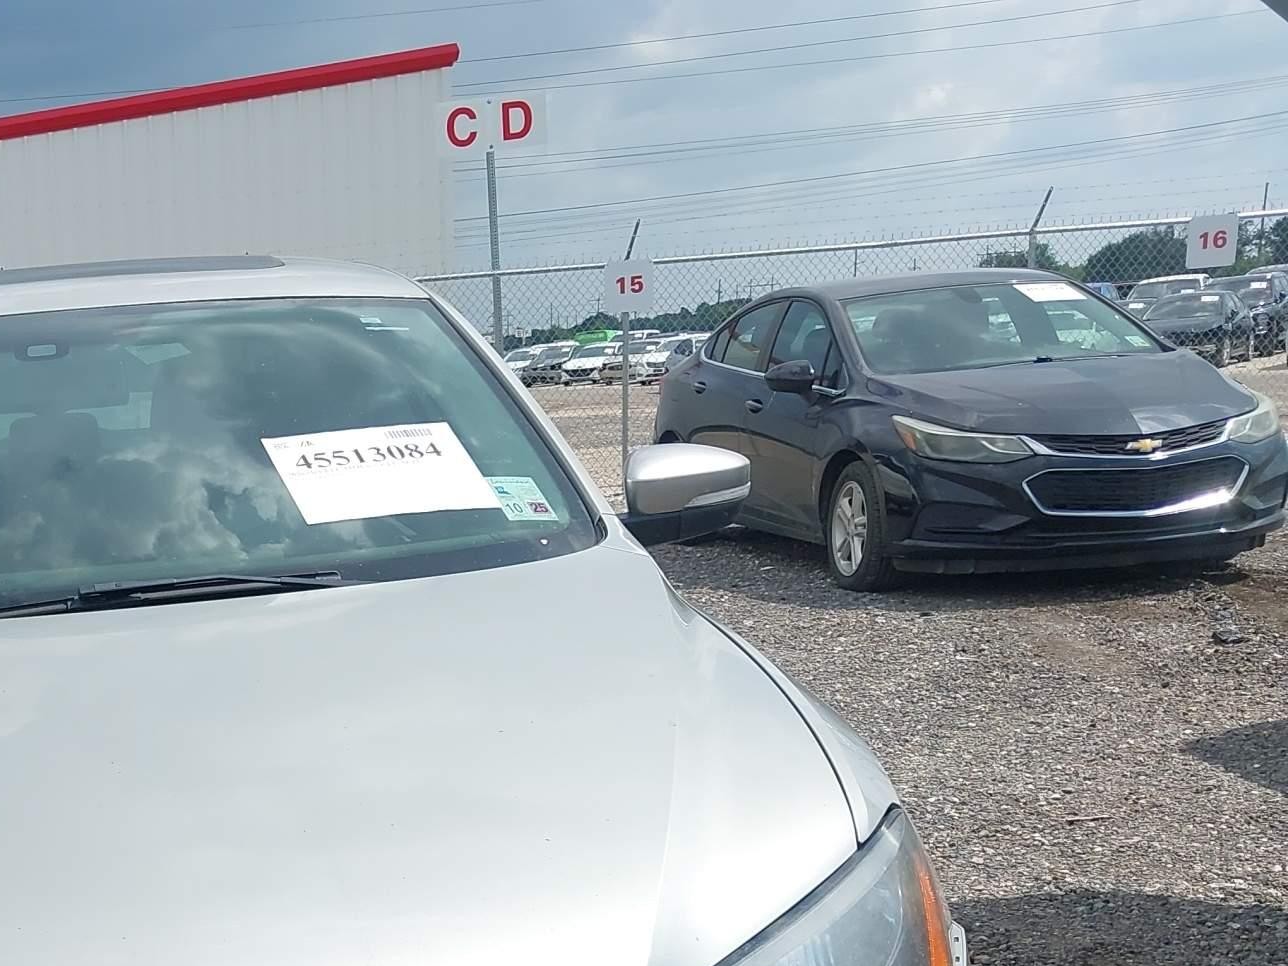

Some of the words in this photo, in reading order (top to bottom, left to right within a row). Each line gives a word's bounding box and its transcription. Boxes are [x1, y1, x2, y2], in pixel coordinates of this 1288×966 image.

[446, 106, 478, 148] C
[501, 100, 533, 141] D
[1199, 230, 1228, 250] 16
[615, 275, 644, 295] 15
[295, 441, 443, 470] 45513084
[505, 502, 524, 514] 10
[527, 502, 549, 513] 25
